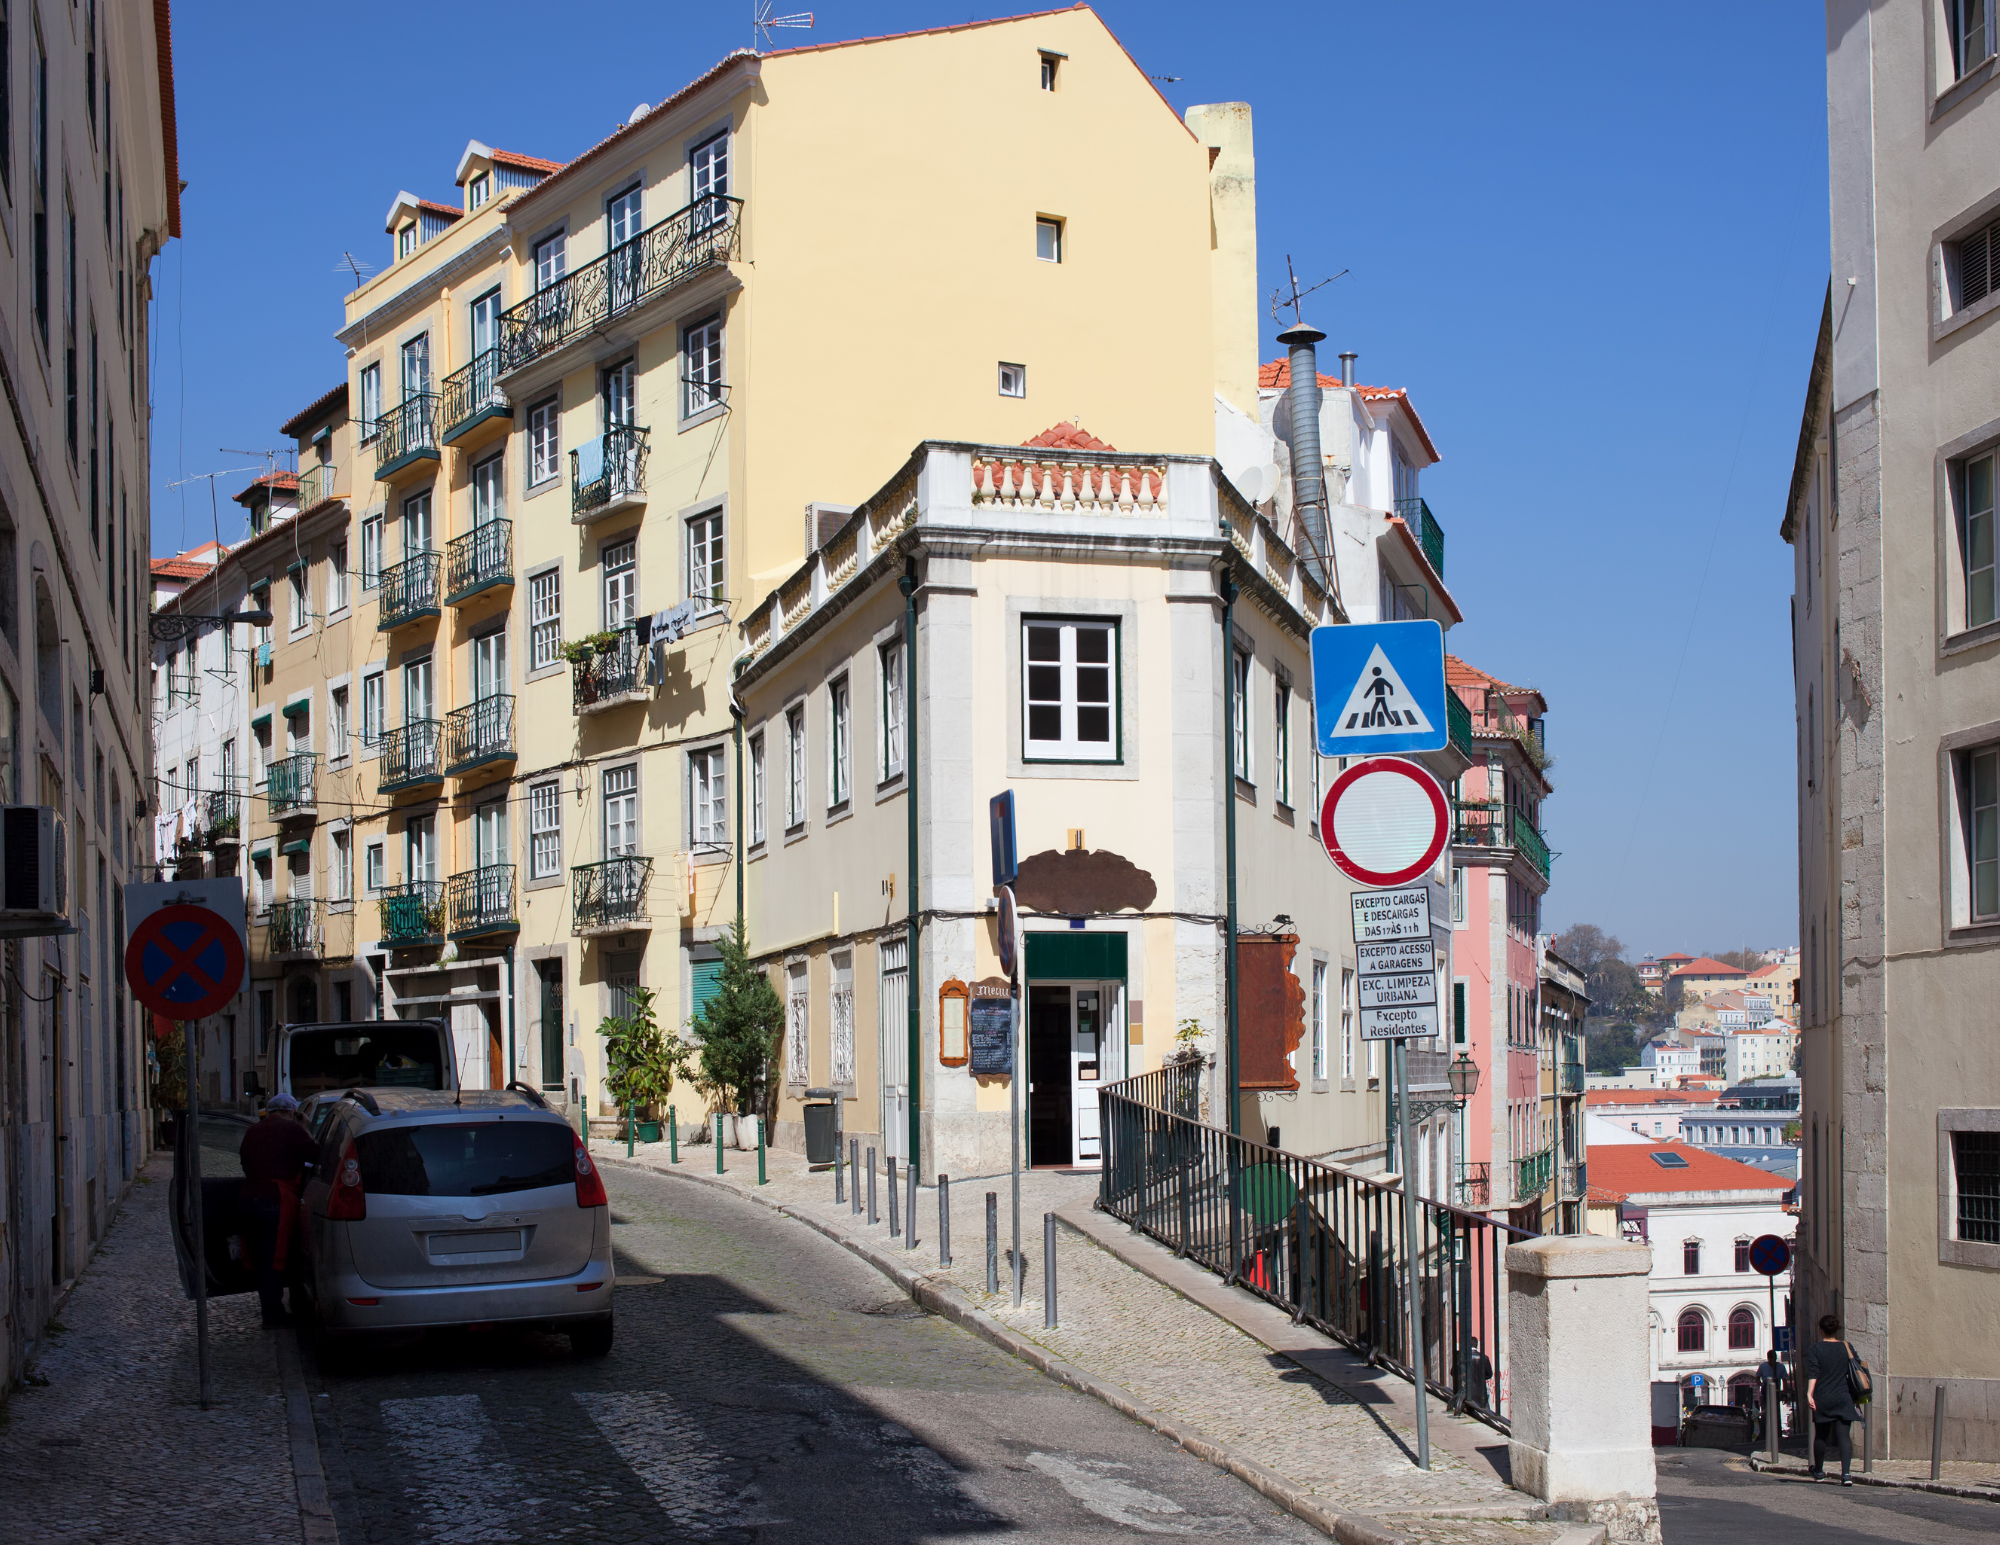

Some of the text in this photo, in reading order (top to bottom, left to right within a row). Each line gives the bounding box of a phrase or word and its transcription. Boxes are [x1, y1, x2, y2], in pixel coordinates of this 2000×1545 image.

[1355, 893, 1426, 909] EXCEPTO CARGAS
[1364, 908, 1419, 922] E DESCARGAS
[1365, 926, 1381, 937] DAS
[1360, 943, 1431, 958] EXCEPTO ACESSO
[1370, 958, 1423, 970] A GARAGENS
[1363, 976, 1431, 991] EXC. LIMPEZA
[976, 986, 1009, 997] Menu
[1377, 990, 1418, 1002] URBANA
[1376, 1010, 1418, 1023] Excepto
[1370, 1024, 1427, 1037] Residentes
[1695, 1376, 1701, 1385] P
